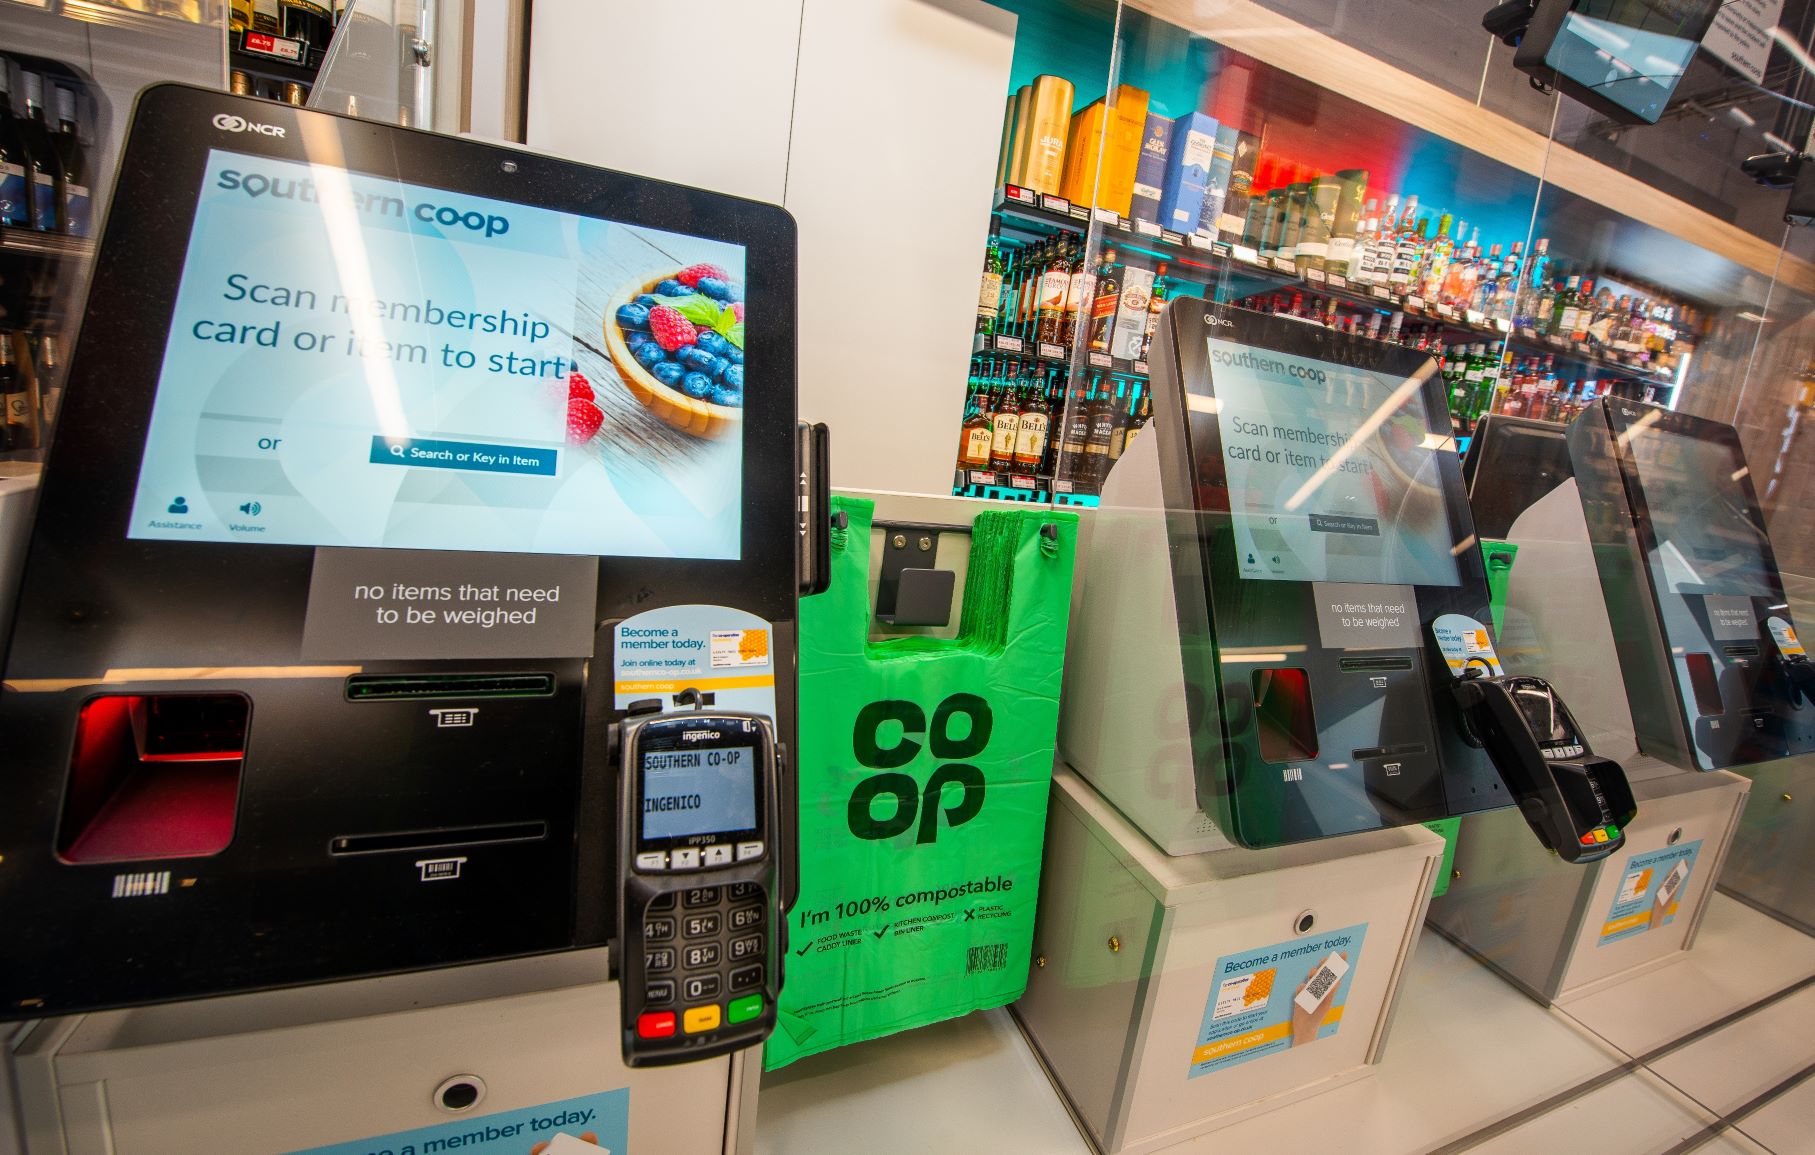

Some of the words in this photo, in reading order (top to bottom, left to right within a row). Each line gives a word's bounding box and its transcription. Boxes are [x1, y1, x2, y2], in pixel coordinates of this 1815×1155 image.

[247, 121, 286, 138] NCR
[1040, 135, 1063, 148] JURA
[217, 169, 404, 218] soutern
[223, 273, 316, 311] Scan
[1217, 318, 1234, 328] NCR
[192, 319, 281, 348] card
[294, 330, 335, 354] or
[442, 343, 476, 369] to
[488, 351, 566, 380] start
[1212, 350, 1286, 376] southern
[971, 432, 990, 441] BELL'S
[1232, 416, 1268, 437] Scan
[1272, 427, 1358, 452] membershi
[258, 438, 282, 450] or
[410, 446, 454, 461] Search
[456, 452, 470, 462] or
[473, 452, 496, 465] Key
[498, 454, 510, 465] in
[512, 455, 540, 467] Item
[1228, 444, 1260, 461] card
[1265, 449, 1280, 464] or
[1284, 448, 1316, 469] item
[148, 520, 202, 530] Assistance
[1268, 516, 1278, 525] or
[229, 524, 266, 532] Volume
[354, 586, 384, 600] no
[392, 583, 452, 601] items
[459, 584, 500, 601] that
[506, 586, 560, 602] need
[1331, 604, 1343, 613] no
[1344, 602, 1366, 613] items
[1368, 603, 1384, 613] that
[1384, 604, 1405, 614] need
[376, 606, 399, 624] to
[406, 606, 436, 624] be
[443, 607, 537, 628] weighed
[1342, 618, 1351, 627] to
[1352, 617, 1364, 627] be
[1366, 617, 1400, 630] weighed
[621, 627, 670, 637] Become
[672, 629, 679, 637] a
[621, 640, 669, 649] member
[672, 638, 706, 650] today.
[639, 659, 662, 667] online
[664, 658, 686, 668] today
[688, 658, 696, 666] at
[682, 730, 720, 742] ingenico
[644, 753, 701, 770] SOUTHERN
[707, 751, 741, 766] CO-OP
[644, 794, 702, 814] INGENICO
[691, 890, 700, 904] 2
[800, 910, 830, 928] I'm
[834, 895, 890, 920] 100%
[895, 876, 1013, 908] compostable
[977, 910, 1012, 920] RECYCLING
[978, 904, 1004, 912] PLASTIC
[736, 912, 745, 926] 6
[894, 917, 921, 928] KITCHEN
[922, 912, 954, 922] COMPOST
[646, 924, 654, 937] 4
[690, 920, 700, 934] 5
[906, 926, 924, 934] LINER
[817, 932, 838, 944] FOOD
[838, 928, 862, 940] WASTE
[736, 942, 744, 956] 9
[816, 940, 840, 953] CADDY
[842, 938, 862, 947] LINER
[690, 950, 700, 964] 8
[1224, 954, 1270, 974] Become
[1271, 953, 1278, 962] a
[1280, 942, 1322, 960] member
[1324, 936, 1352, 950] today.
[691, 981, 702, 996] 0
[1204, 1040, 1242, 1056] southern
[424, 1122, 525, 1155] member
[530, 1108, 597, 1132] today.
